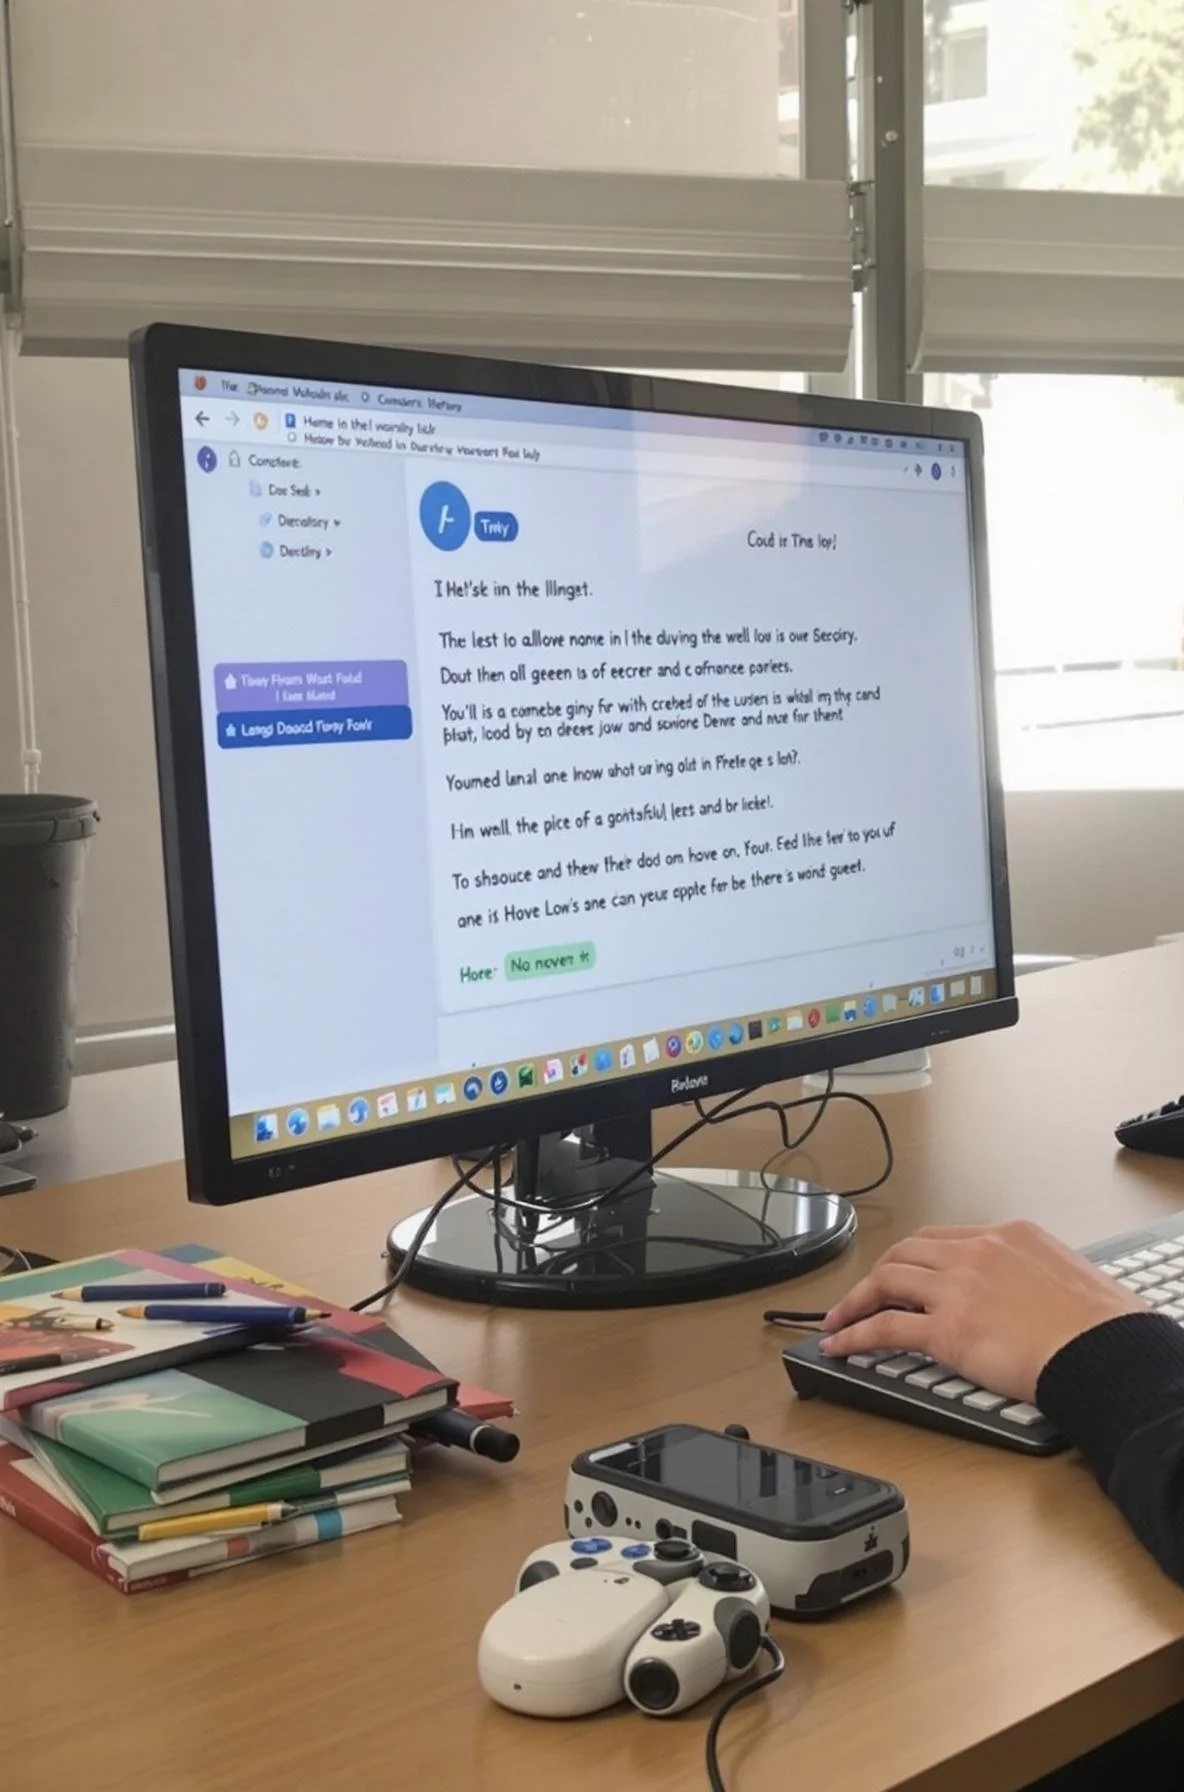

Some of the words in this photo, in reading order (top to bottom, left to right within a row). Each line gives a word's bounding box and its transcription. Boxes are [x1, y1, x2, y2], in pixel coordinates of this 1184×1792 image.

[516, 580, 540, 598] the
[439, 631, 466, 649] The
[632, 628, 652, 646] the
[702, 628, 722, 644] the
[726, 626, 750, 644] well
[776, 628, 786, 642] is
[592, 662, 608, 680] of
[657, 660, 681, 678] and
[441, 702, 478, 722] You'll
[482, 704, 493, 720] is
[618, 694, 648, 714] with
[697, 694, 709, 710] of
[712, 693, 730, 708] the
[772, 690, 782, 705] is
[516, 724, 533, 744] by
[628, 716, 652, 733] and
[741, 709, 763, 727] and
[702, 756, 712, 771] in
[516, 816, 539, 835] the
[576, 810, 591, 829] of
[699, 798, 722, 816] and
[452, 872, 470, 890] To
[538, 862, 562, 880] and
[848, 830, 860, 842] to
[732, 875, 746, 892] be
